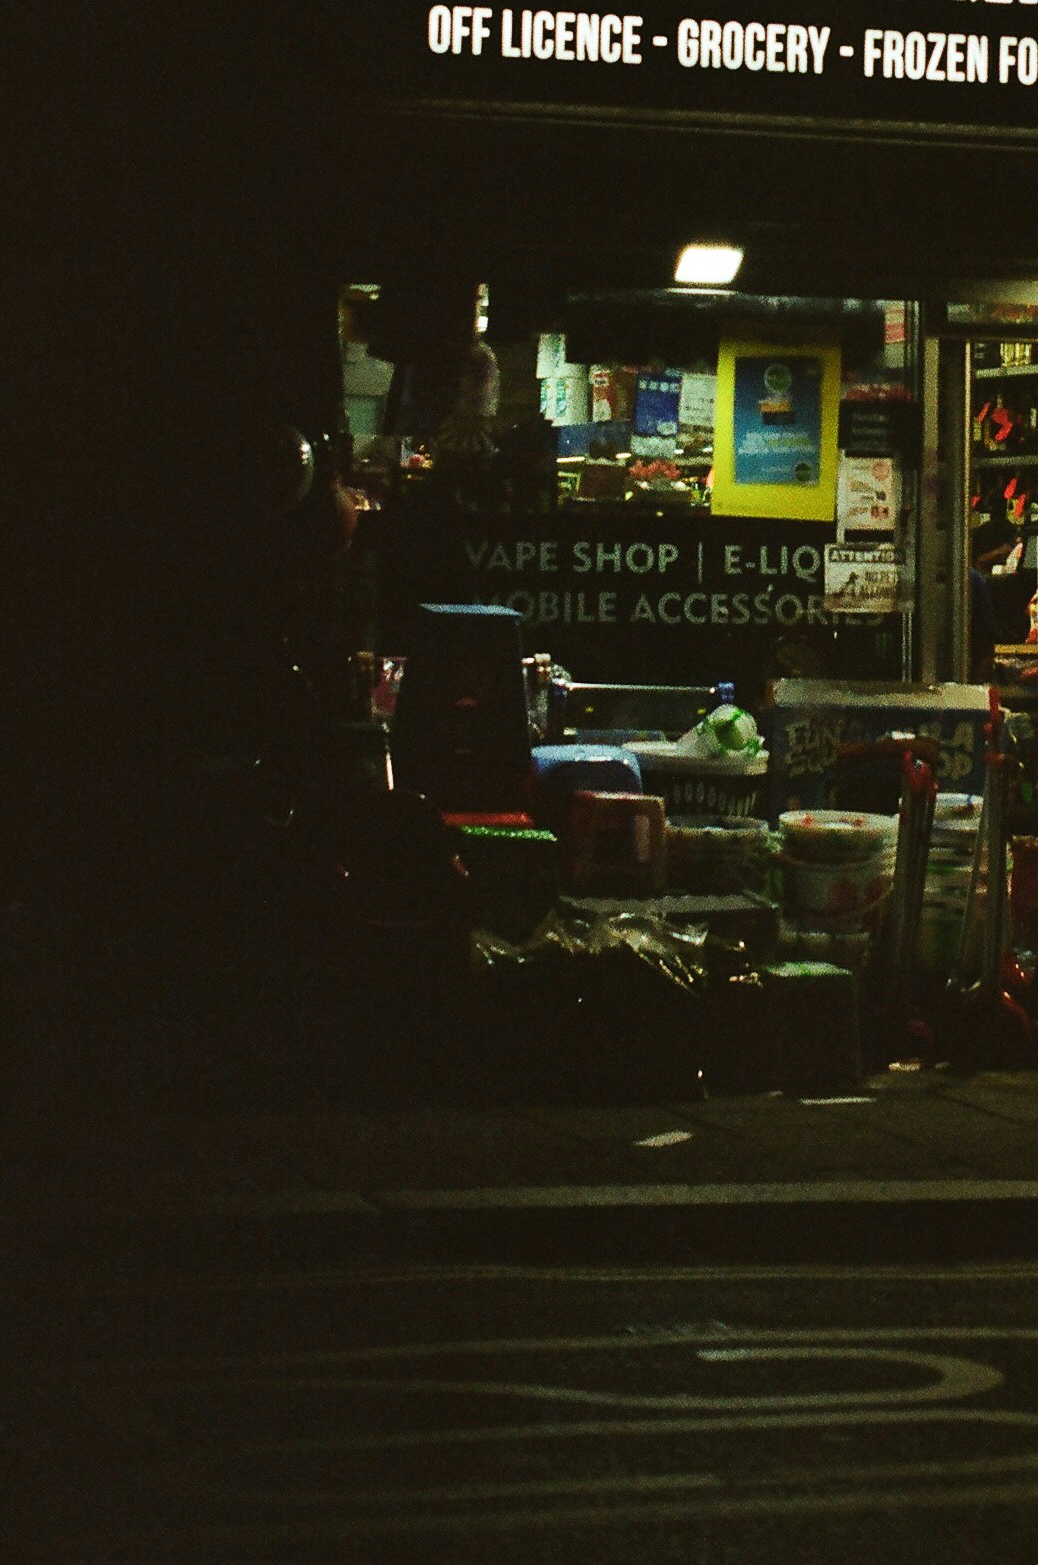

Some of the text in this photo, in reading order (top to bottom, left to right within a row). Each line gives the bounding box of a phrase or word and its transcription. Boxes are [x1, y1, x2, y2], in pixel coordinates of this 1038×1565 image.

[428, 4, 493, 56] OFF
[501, 8, 644, 65] LICENCE
[677, 17, 831, 75] GROCERY
[863, 28, 989, 84] FROZEN
[463, 540, 559, 573] VAPE
[572, 540, 681, 574] SHOP
[723, 544, 823, 583] E-LIQ
[473, 589, 883, 627] OBILE ACCESSOR
